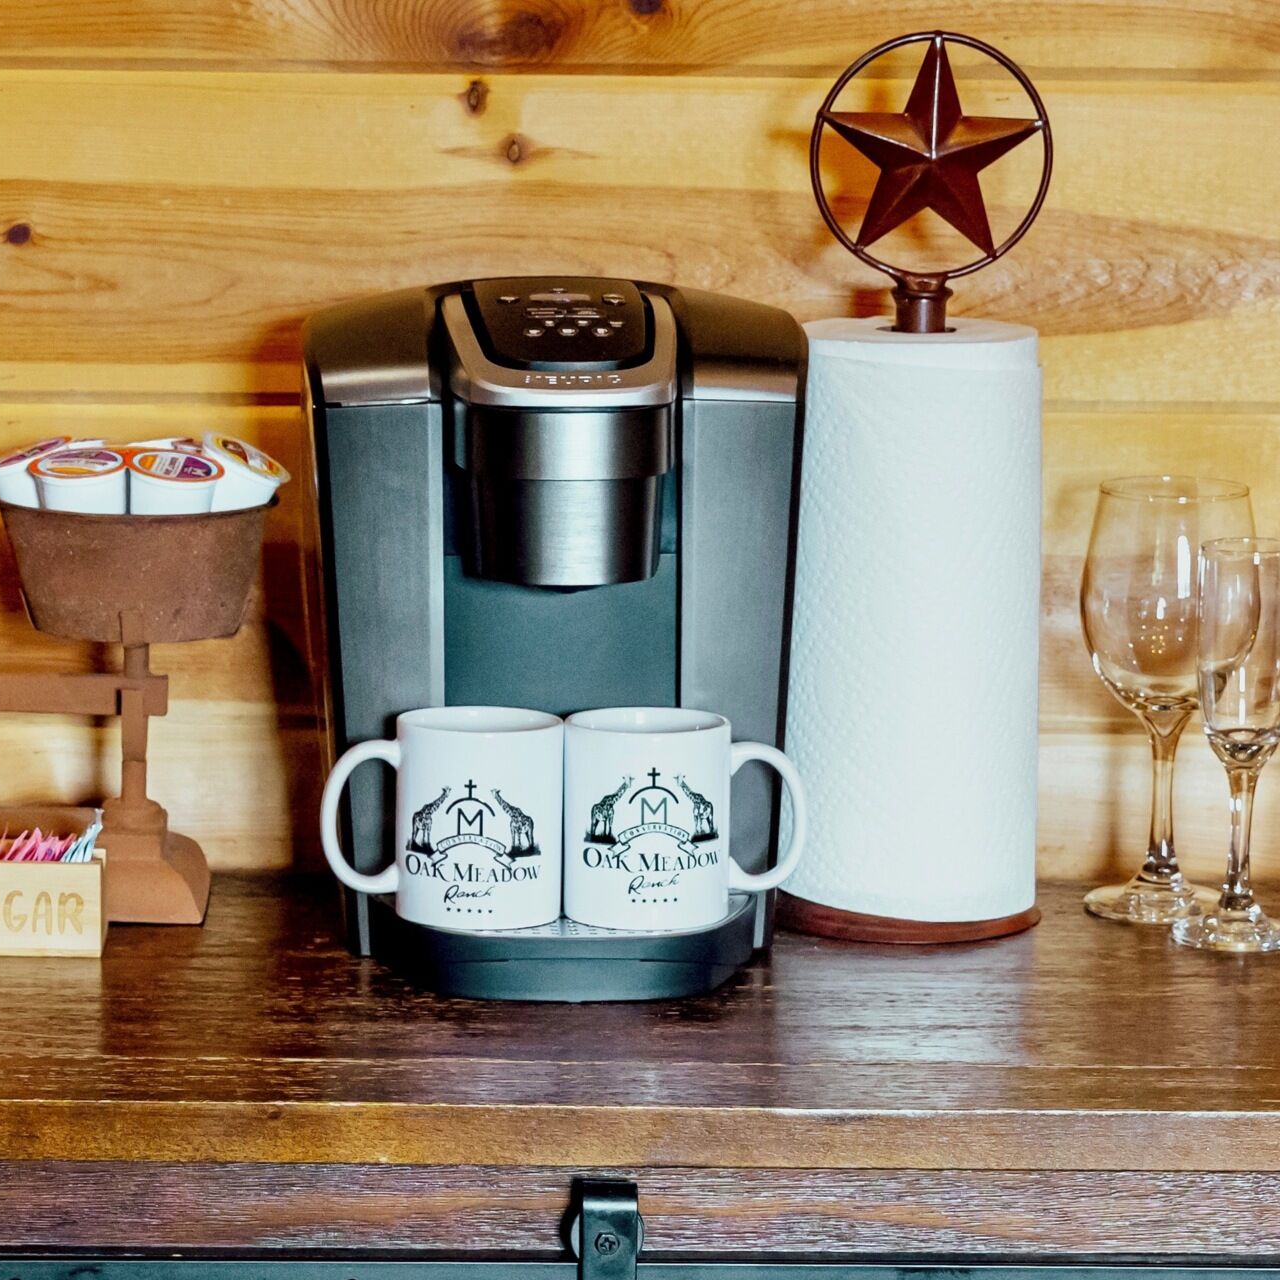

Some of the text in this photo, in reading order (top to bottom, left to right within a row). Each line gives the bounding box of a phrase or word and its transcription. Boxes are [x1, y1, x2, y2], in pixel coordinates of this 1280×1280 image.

[457, 808, 483, 836] M
[641, 797, 667, 825] M
[405, 854, 541, 883] OAK MEADOW
[583, 847, 720, 873] OAK MEADOW
[444, 884, 496, 904] Ranch
[628, 873, 680, 895] Ranch
